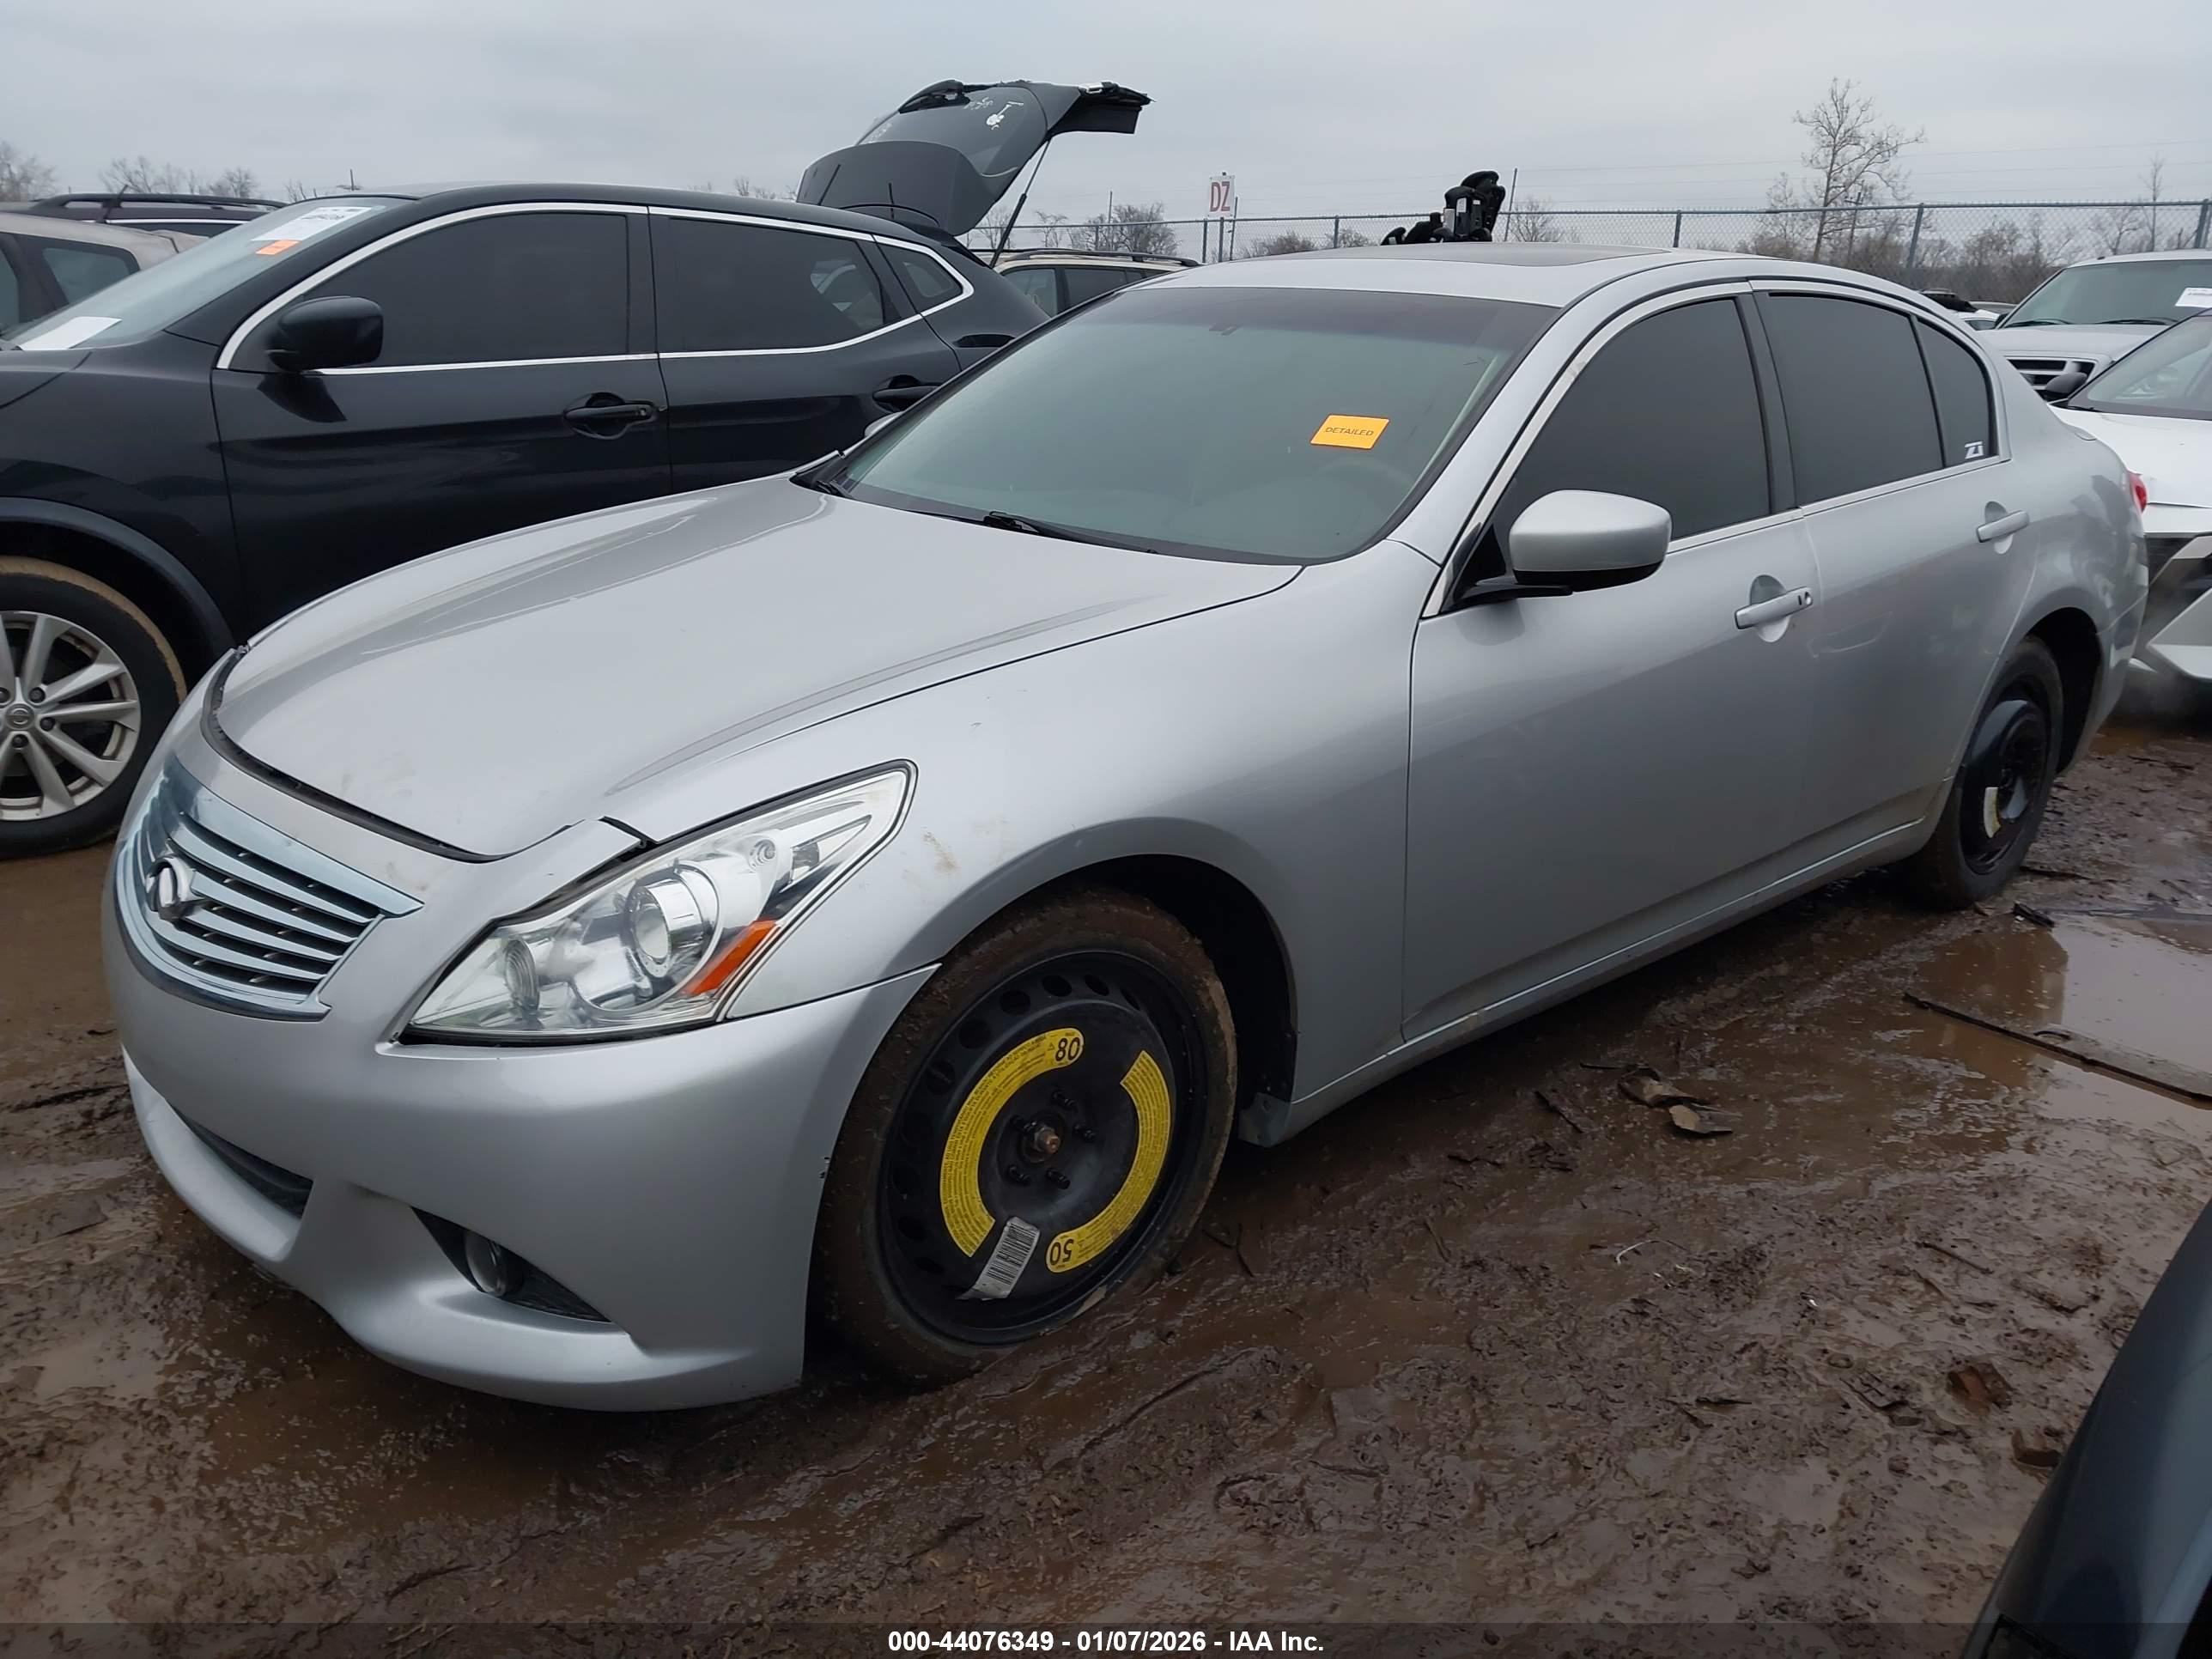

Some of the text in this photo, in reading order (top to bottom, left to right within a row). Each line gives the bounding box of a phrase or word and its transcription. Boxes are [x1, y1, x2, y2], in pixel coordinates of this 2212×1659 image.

[1210, 181, 1231, 212] DZ
[1325, 427, 1374, 436] DETAILED
[1055, 1036, 1081, 1061] 80
[1049, 1238, 1074, 1266] 50
